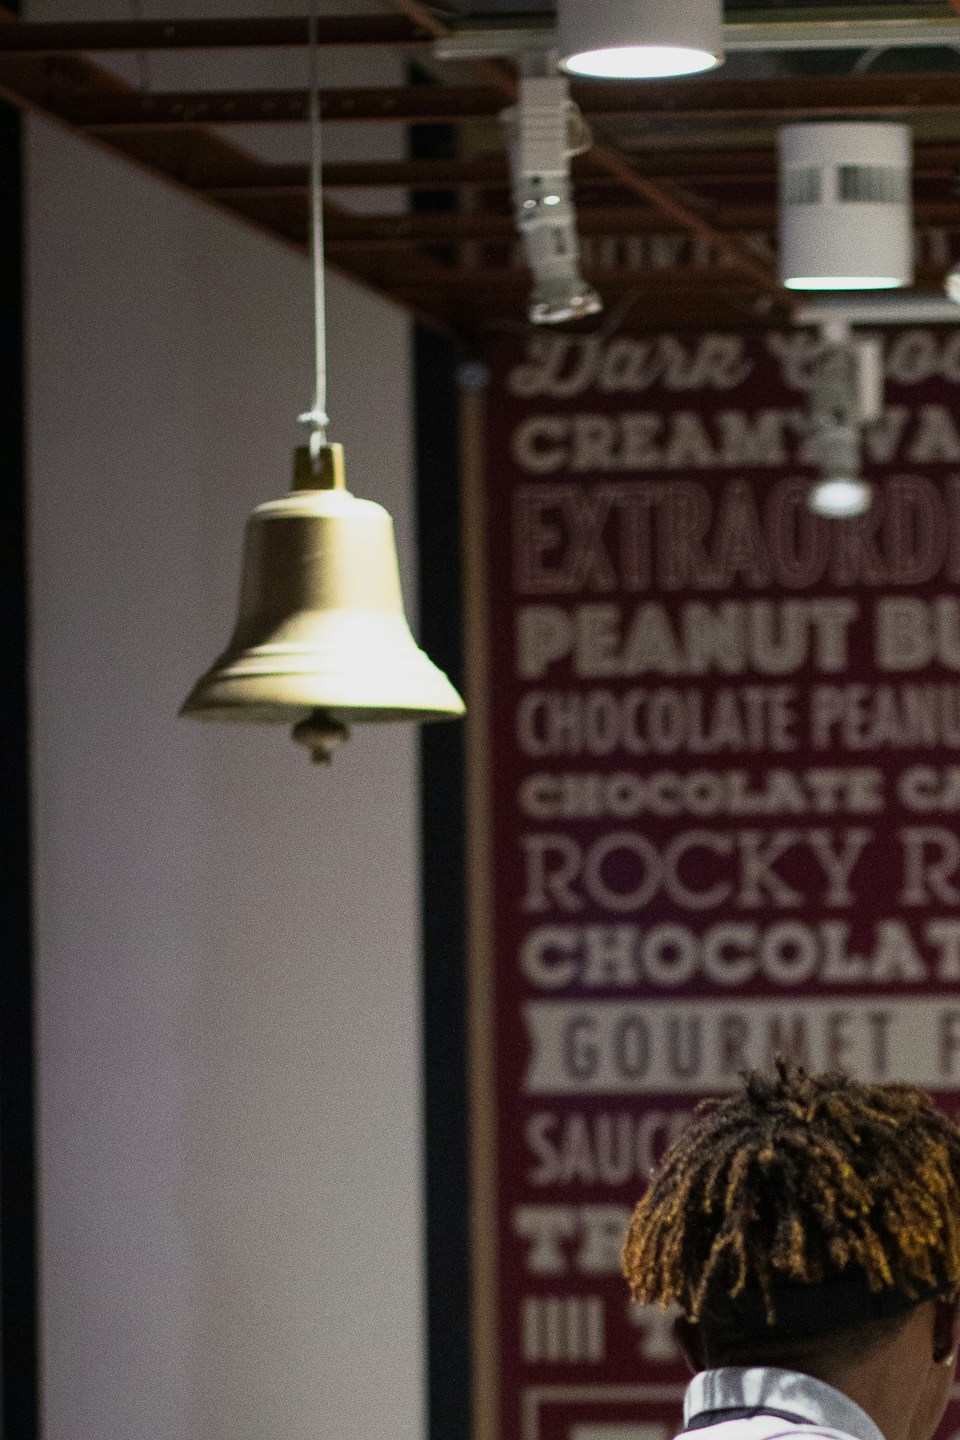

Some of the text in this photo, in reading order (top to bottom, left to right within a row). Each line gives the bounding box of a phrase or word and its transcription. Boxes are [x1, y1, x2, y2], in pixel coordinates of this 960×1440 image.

[516, 602, 858, 680] PEANUT
[518, 689, 800, 756] CHOCOLATE
[520, 768, 884, 818] CHOCOLATE
[522, 830, 872, 912] ROCKY
